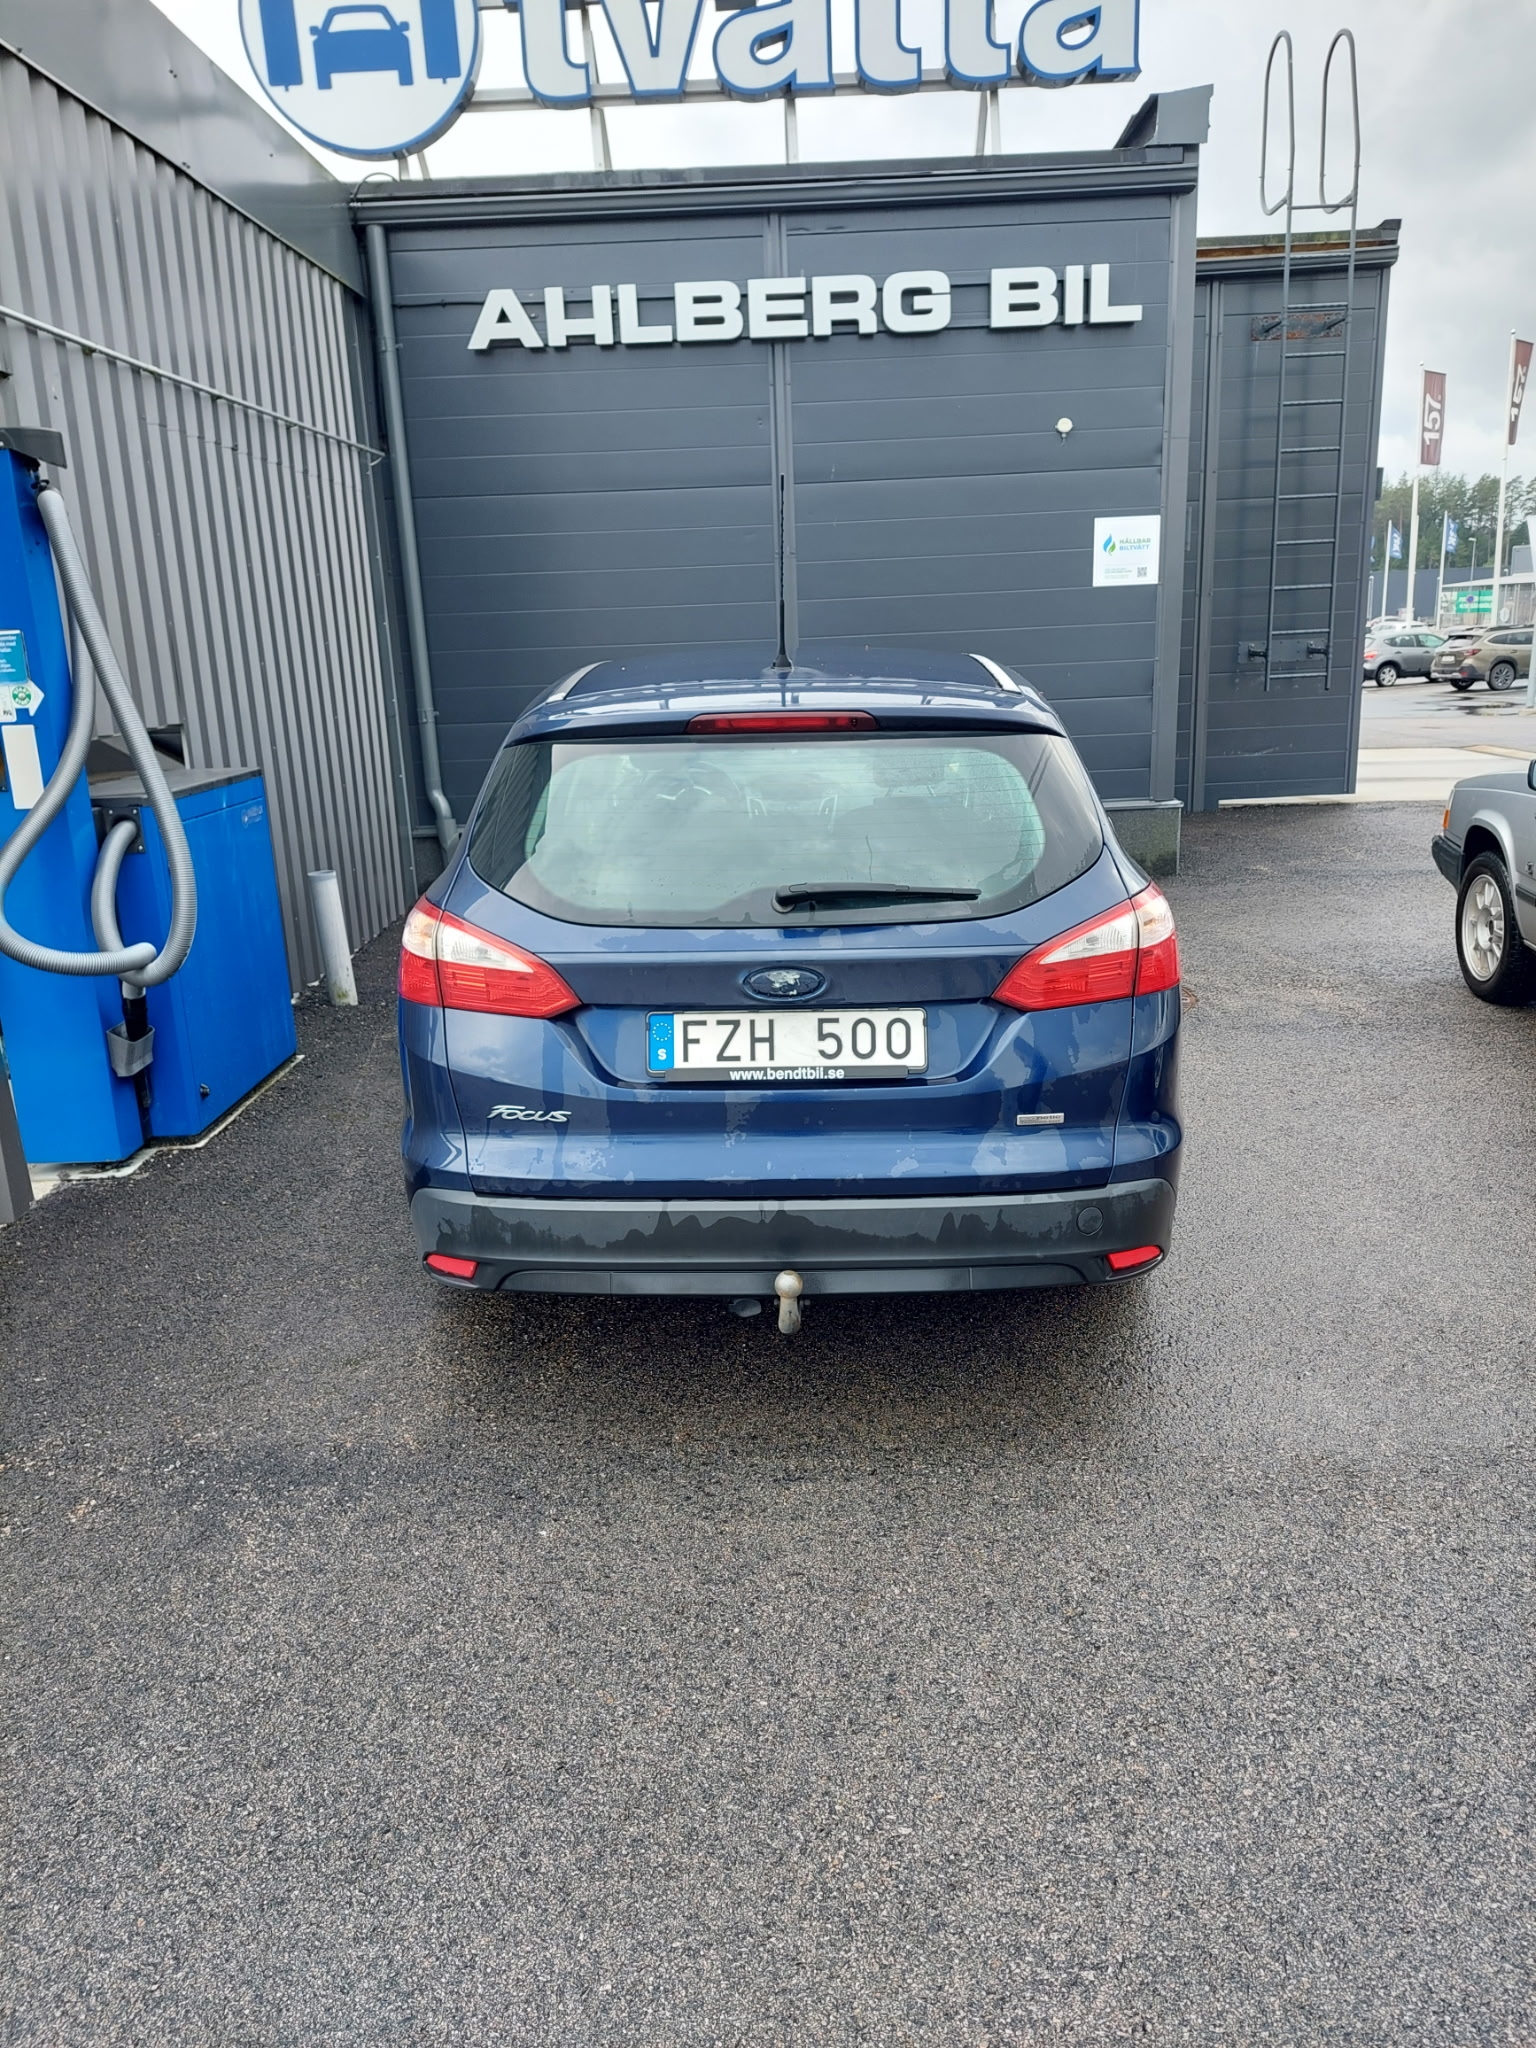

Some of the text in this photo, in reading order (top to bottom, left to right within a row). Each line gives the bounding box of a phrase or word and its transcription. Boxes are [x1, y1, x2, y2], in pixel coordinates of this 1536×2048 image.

[467, 263, 1143, 351] AHLBERG BIL
[657, 1048, 667, 1060] S
[682, 1017, 912, 1062] FZH 500
[729, 1066, 845, 1080] www.bendtbil.se
